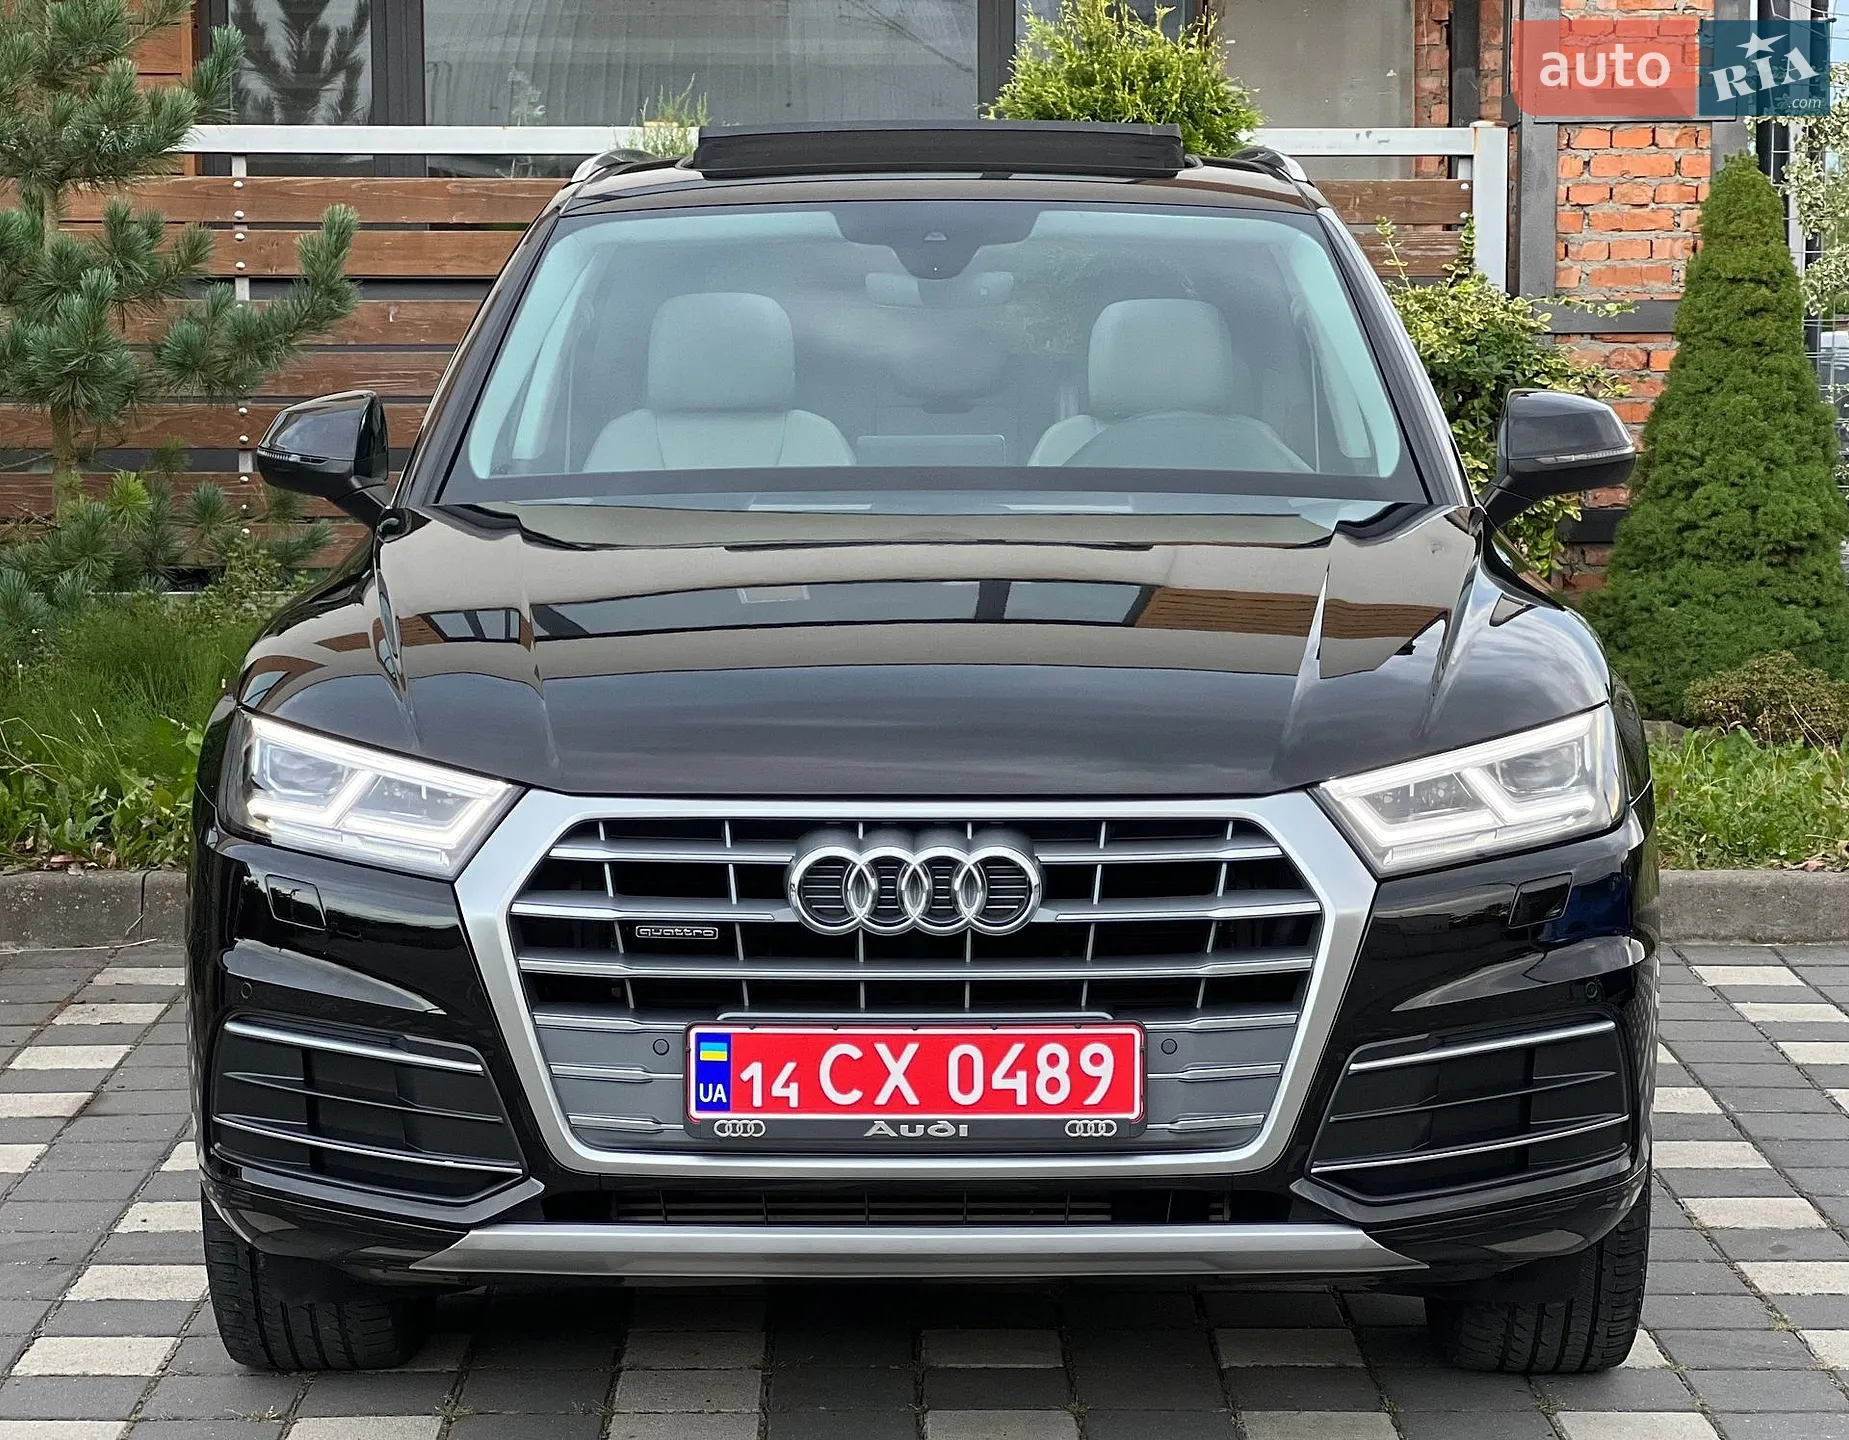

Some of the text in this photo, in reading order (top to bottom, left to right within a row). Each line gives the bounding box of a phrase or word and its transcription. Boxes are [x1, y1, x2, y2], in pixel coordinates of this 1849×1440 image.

[639, 928, 715, 937] quattro
[739, 1042, 1115, 1108] 14 CX 0489
[699, 1083, 728, 1103] UA
[863, 1120, 968, 1138] Audi
